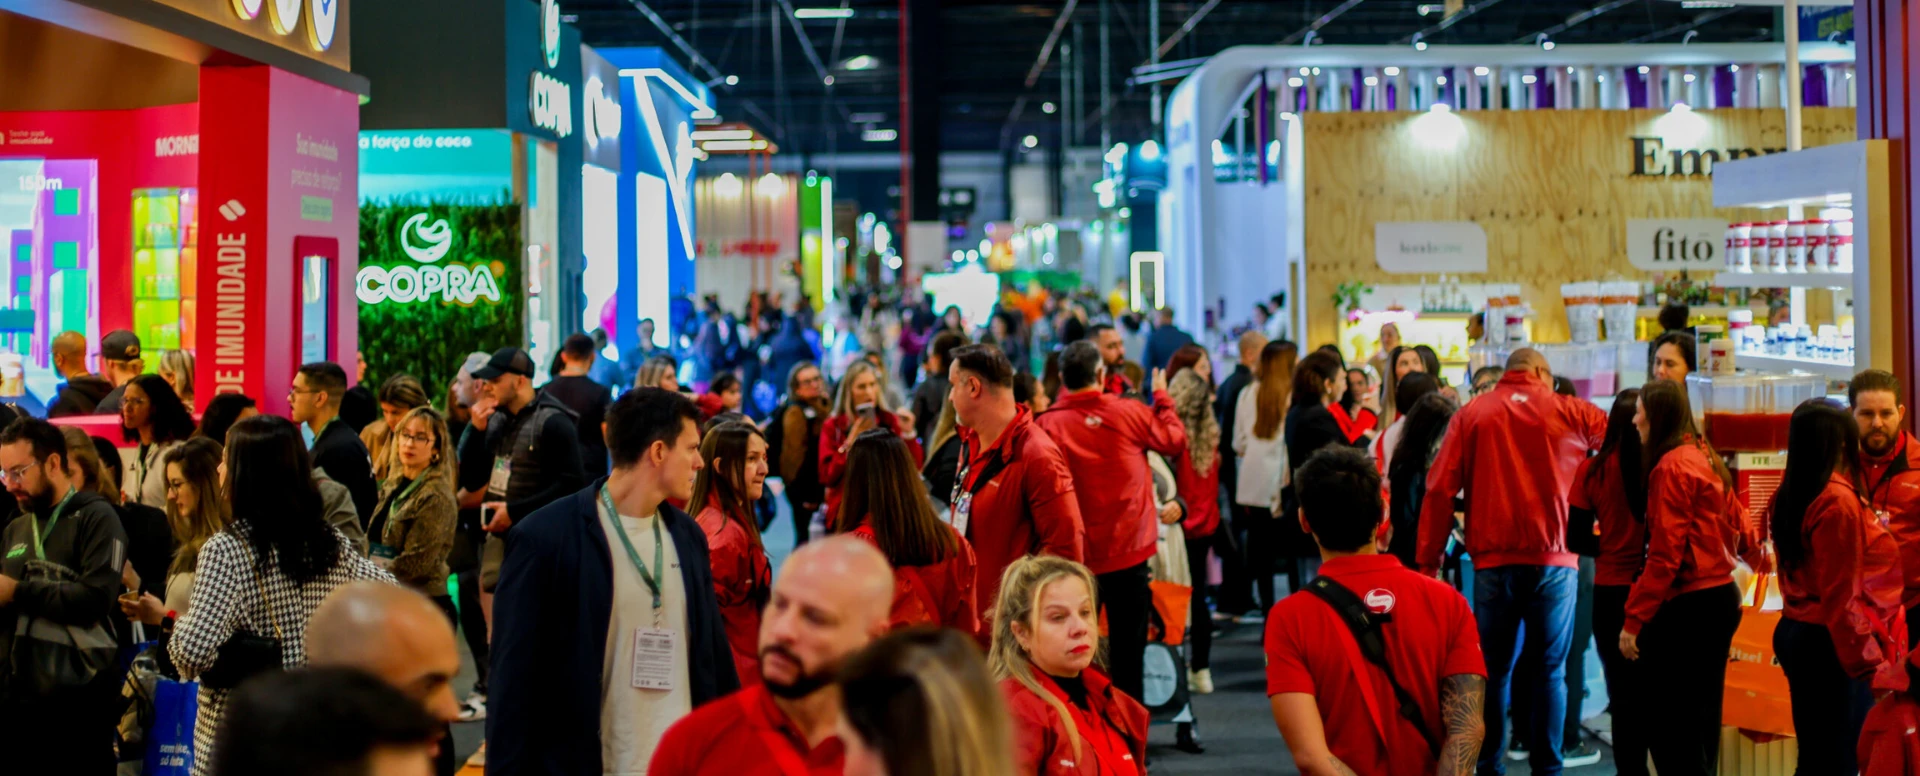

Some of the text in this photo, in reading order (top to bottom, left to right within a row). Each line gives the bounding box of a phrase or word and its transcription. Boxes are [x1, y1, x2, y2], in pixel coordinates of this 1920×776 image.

[372, 134, 411, 152] força
[413, 134, 433, 148] do
[18, 175, 62, 191] 150m
[215, 232, 246, 365] IMUNIDADE
[355, 264, 501, 304] COPRA
